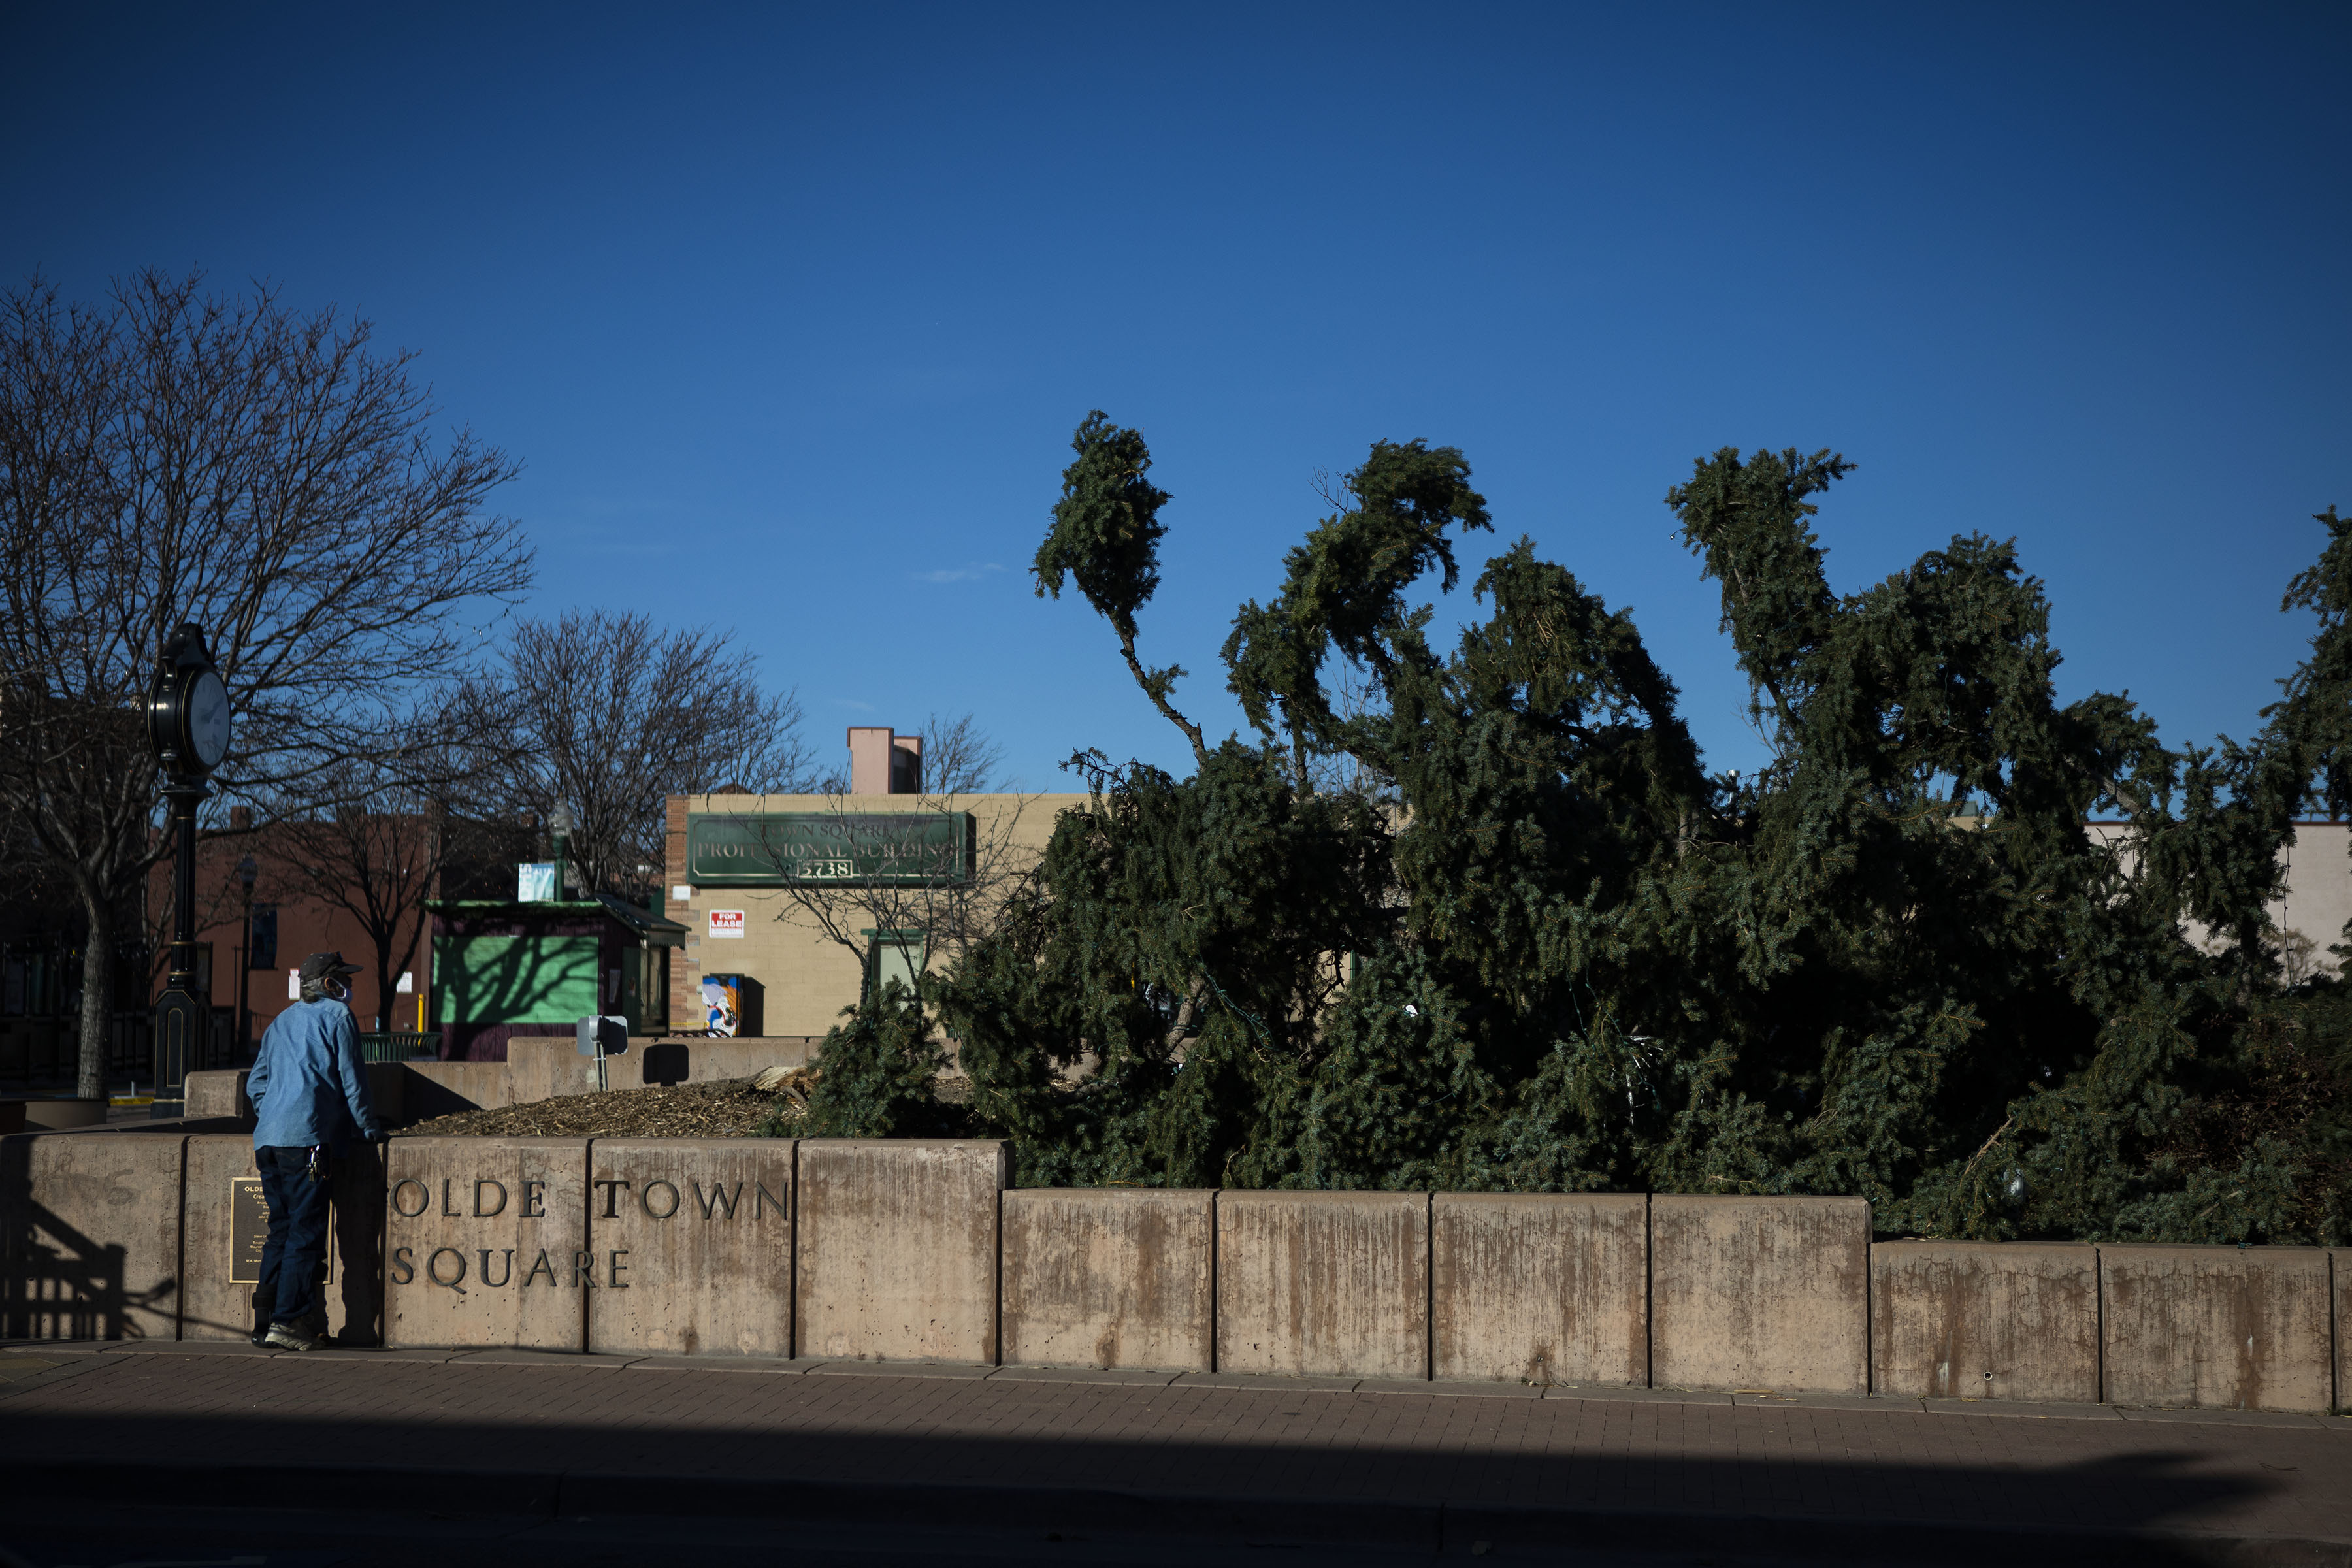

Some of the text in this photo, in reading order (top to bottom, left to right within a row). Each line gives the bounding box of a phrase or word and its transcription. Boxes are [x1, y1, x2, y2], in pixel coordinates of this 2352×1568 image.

[758, 825, 814, 837] TOWN
[698, 842, 847, 858] PROFESSIONAL
[802, 862, 849, 876] 5738
[389, 1178, 788, 1220] OLDE TOWN
[391, 1246, 629, 1294] SQUARE
